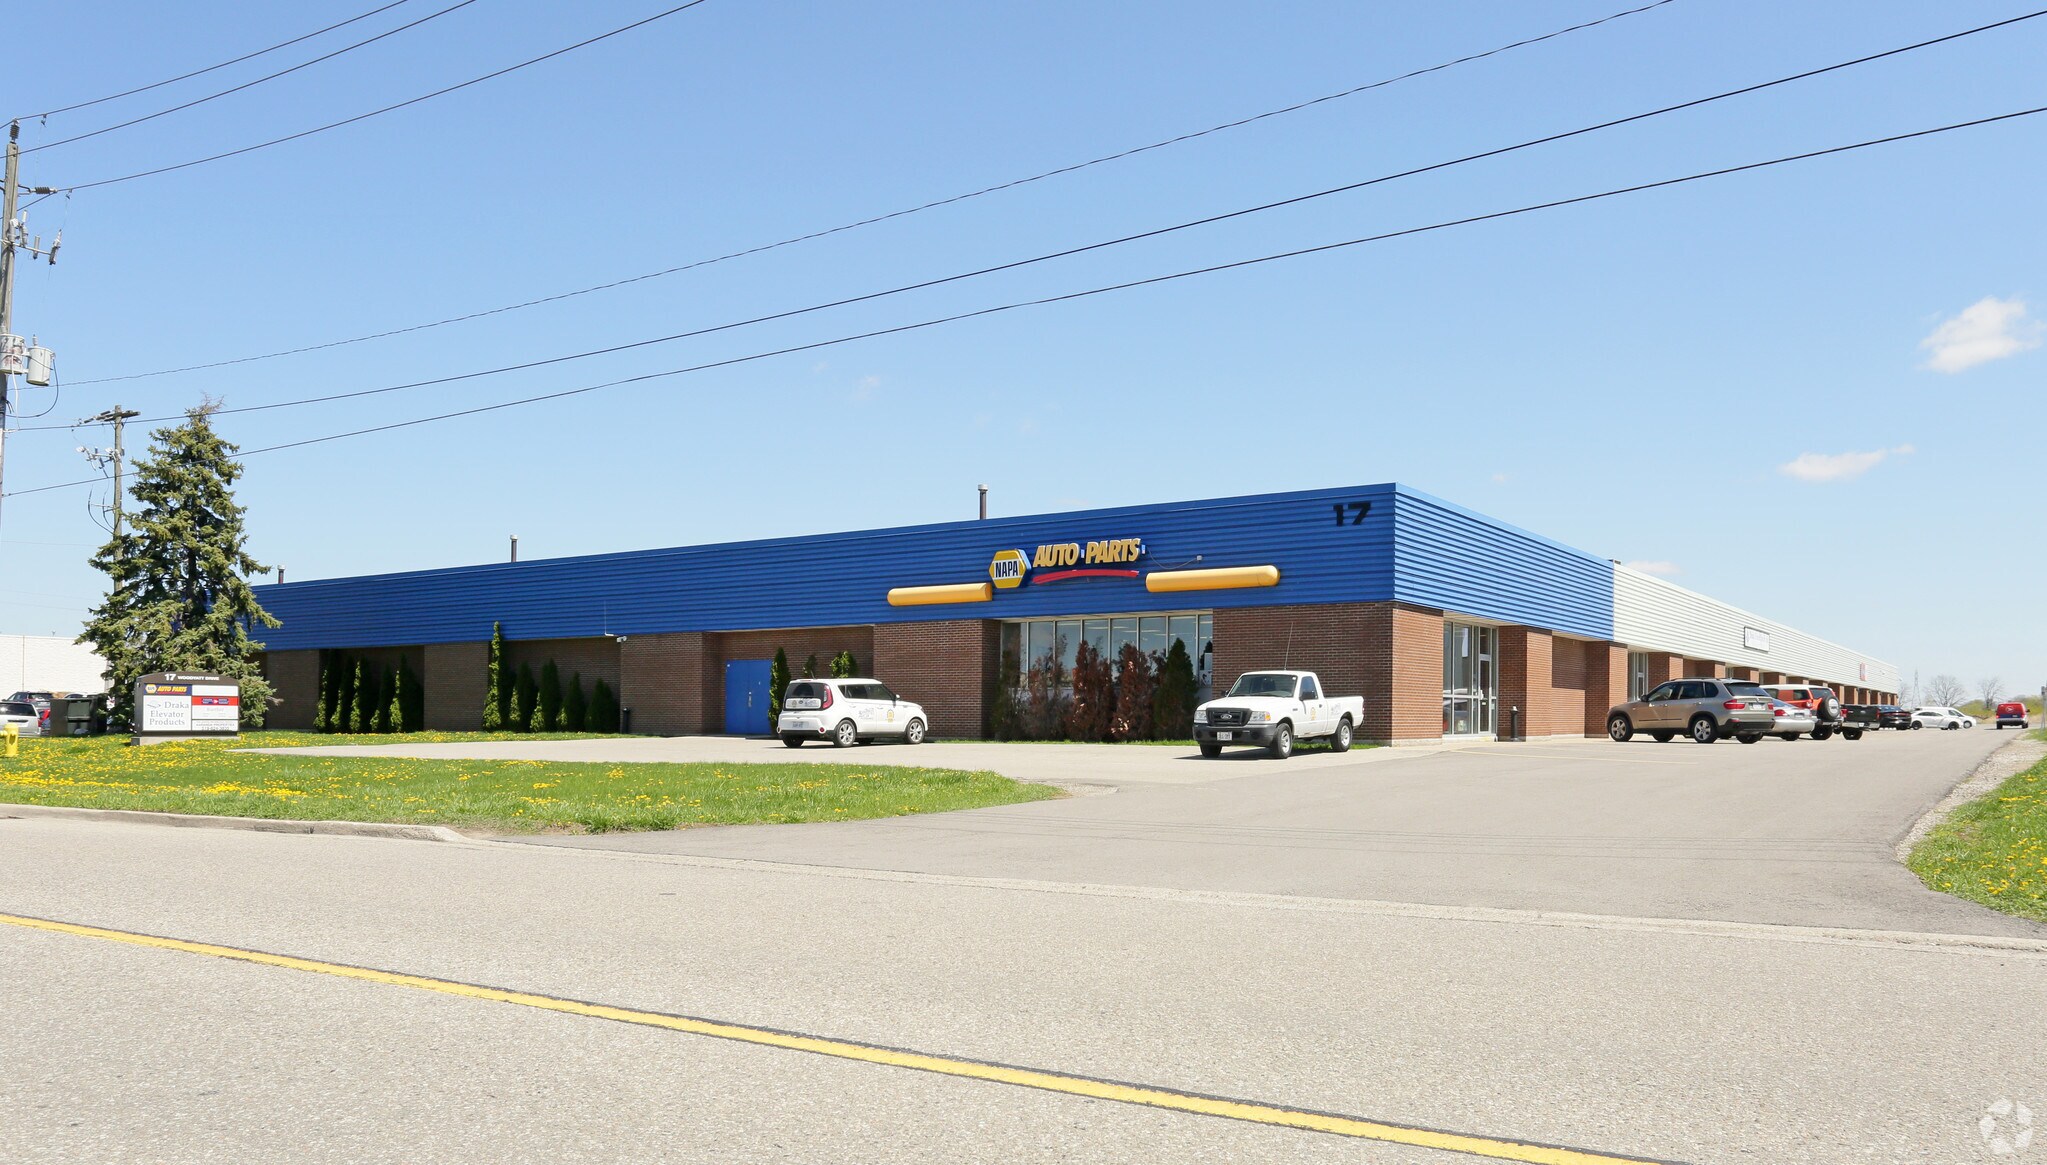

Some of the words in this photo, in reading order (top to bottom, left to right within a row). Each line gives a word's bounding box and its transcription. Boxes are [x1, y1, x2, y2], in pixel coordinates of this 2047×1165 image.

[1332, 501, 1371, 527] 17
[995, 561, 1019, 578] NAPA
[1033, 543, 1079, 568] AUTO
[1085, 538, 1141, 564] PARTS
[164, 673, 176, 681] 17
[164, 701, 190, 709] Draka
[150, 710, 184, 718] Elevator
[149, 718, 185, 726] Products
